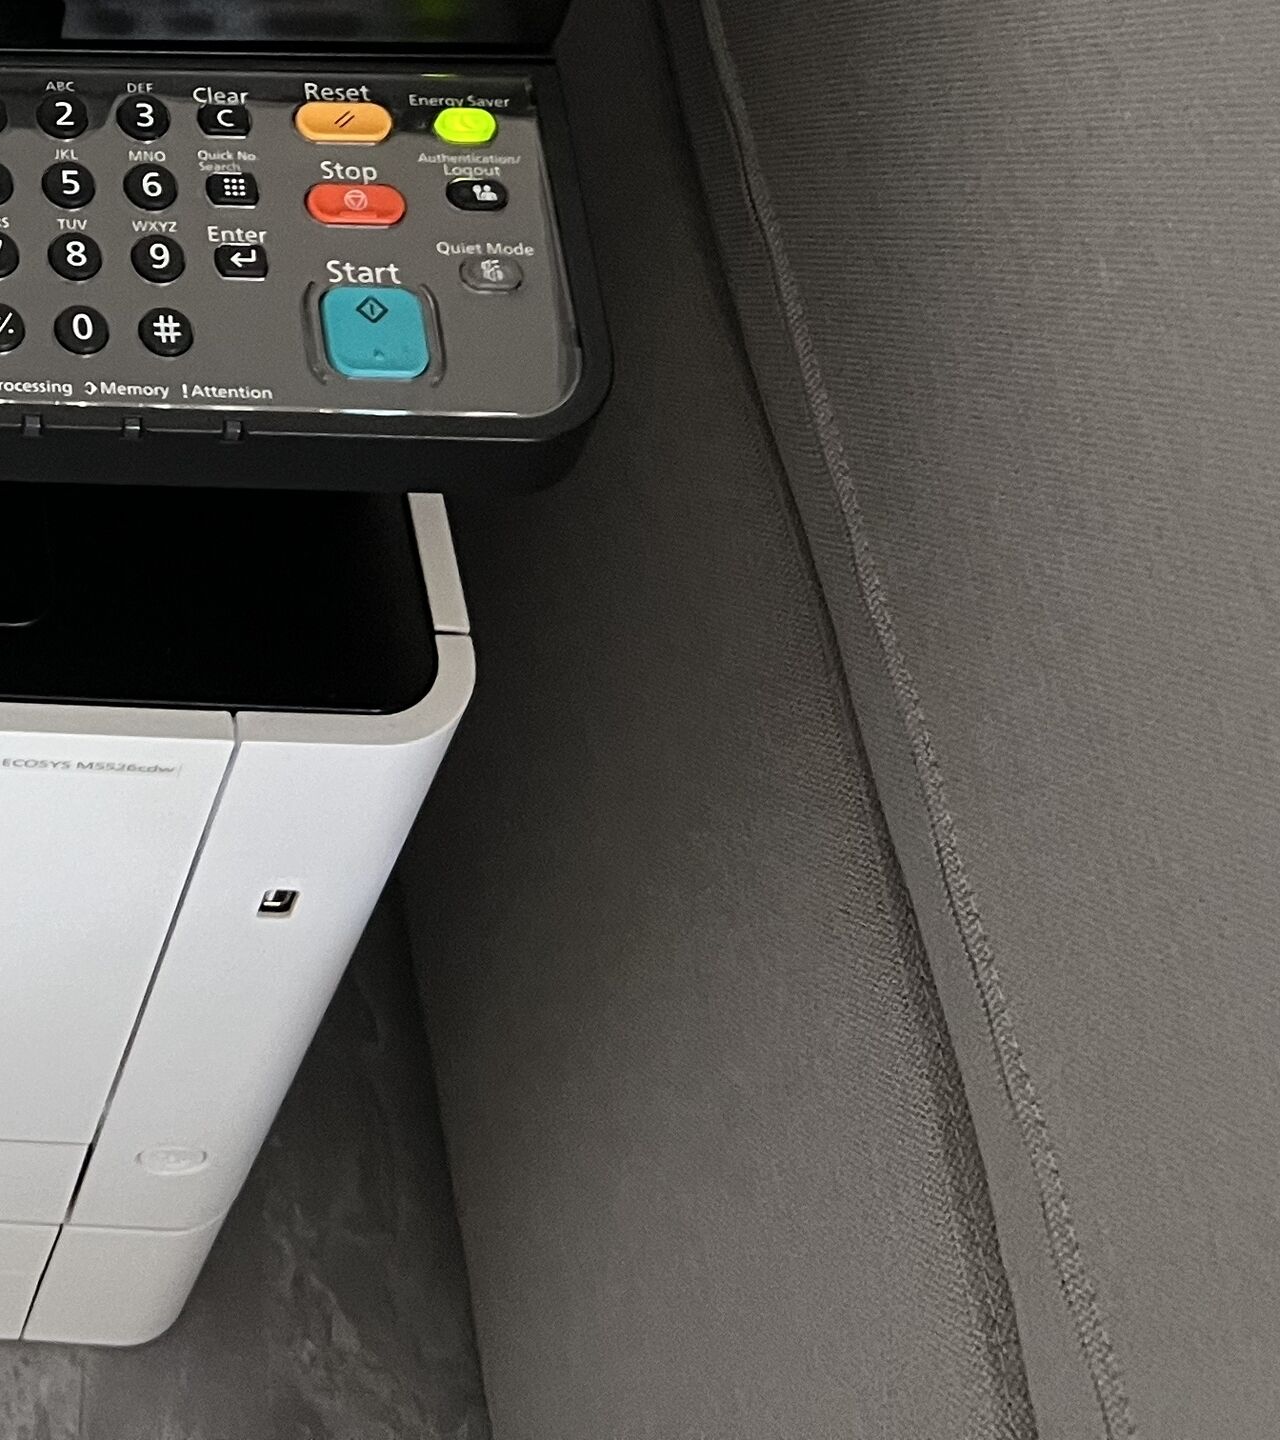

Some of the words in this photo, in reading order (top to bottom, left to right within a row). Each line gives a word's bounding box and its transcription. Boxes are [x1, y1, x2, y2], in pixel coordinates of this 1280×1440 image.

[45, 81, 76, 92] ABC
[126, 82, 154, 94] DEF
[304, 82, 371, 102] Reset
[192, 87, 250, 105] Clear
[408, 94, 465, 108] Energy
[467, 95, 511, 109] Saver
[54, 101, 75, 126] 2
[135, 102, 155, 128] 3
[216, 109, 235, 127] C
[54, 148, 79, 161] JKL
[128, 149, 167, 162] MNO
[197, 149, 234, 162] Quick
[198, 161, 242, 173] Search
[320, 160, 379, 184] Stop
[443, 163, 501, 178] Logout
[61, 169, 81, 195] 5
[142, 171, 163, 197] 6
[57, 218, 88, 230] TUV
[131, 220, 178, 233] WXYZ
[206, 225, 268, 244] Enter
[66, 240, 88, 267] 8
[149, 243, 171, 269] 9
[435, 241, 482, 257] Quiet
[486, 242, 535, 257] Mode
[326, 260, 403, 284] Start
[72, 313, 94, 341] 0
[152, 314, 183, 344] #
[99, 381, 170, 400] Memory
[2, 757, 72, 770] ECOSYS
